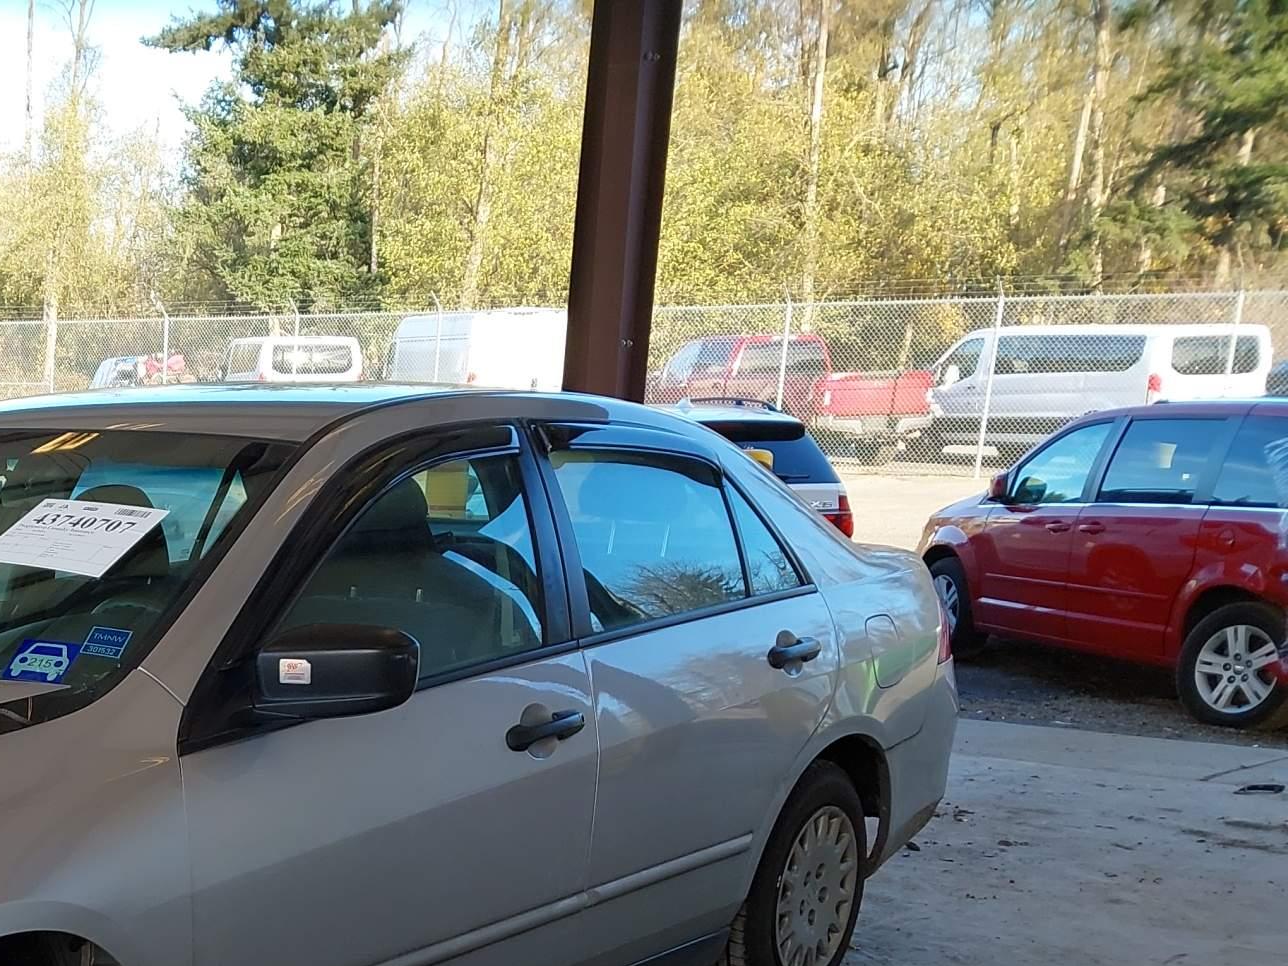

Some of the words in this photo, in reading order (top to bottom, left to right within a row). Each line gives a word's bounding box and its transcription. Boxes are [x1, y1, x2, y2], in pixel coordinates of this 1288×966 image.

[32, 512, 138, 534] 43740707
[93, 632, 126, 643] TMNW
[87, 645, 116, 656] 301532
[27, 657, 54, 668] 215
